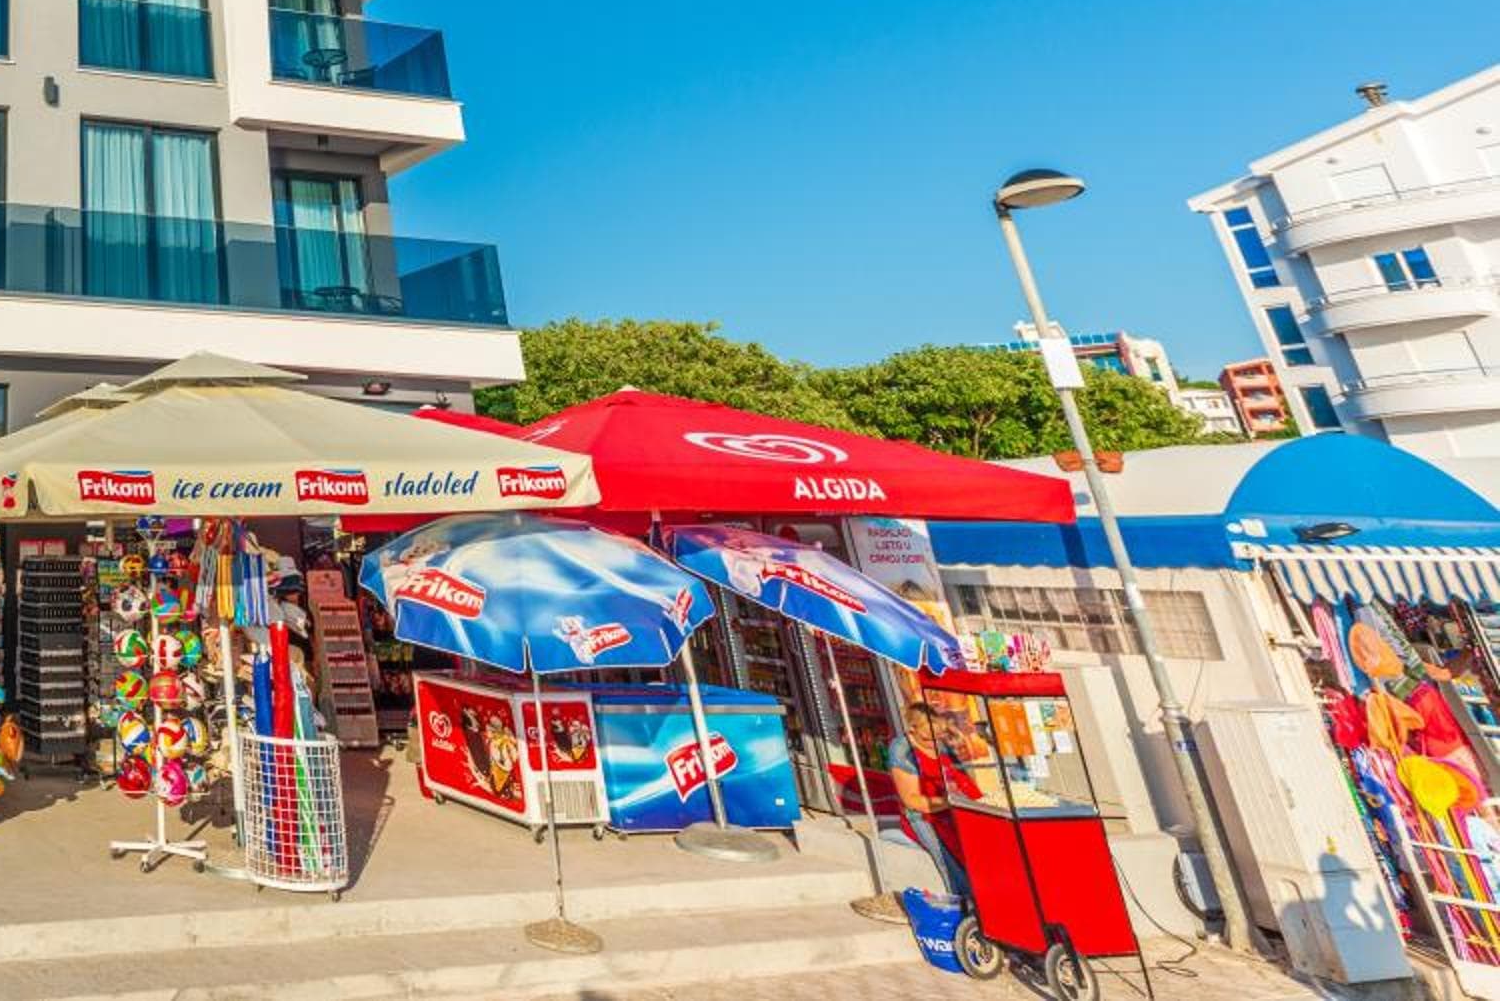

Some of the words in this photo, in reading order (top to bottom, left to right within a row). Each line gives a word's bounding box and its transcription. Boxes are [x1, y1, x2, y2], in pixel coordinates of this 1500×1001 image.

[82, 478, 152, 497] Frikom
[172, 478, 204, 499] ice
[209, 481, 282, 499] cream
[299, 477, 367, 496] Frikom
[384, 470, 480, 497] sladoled
[501, 474, 566, 494] Frikom
[794, 477, 887, 501] ALGIDA
[403, 571, 484, 611] Frikom
[673, 742, 730, 787] Friom
